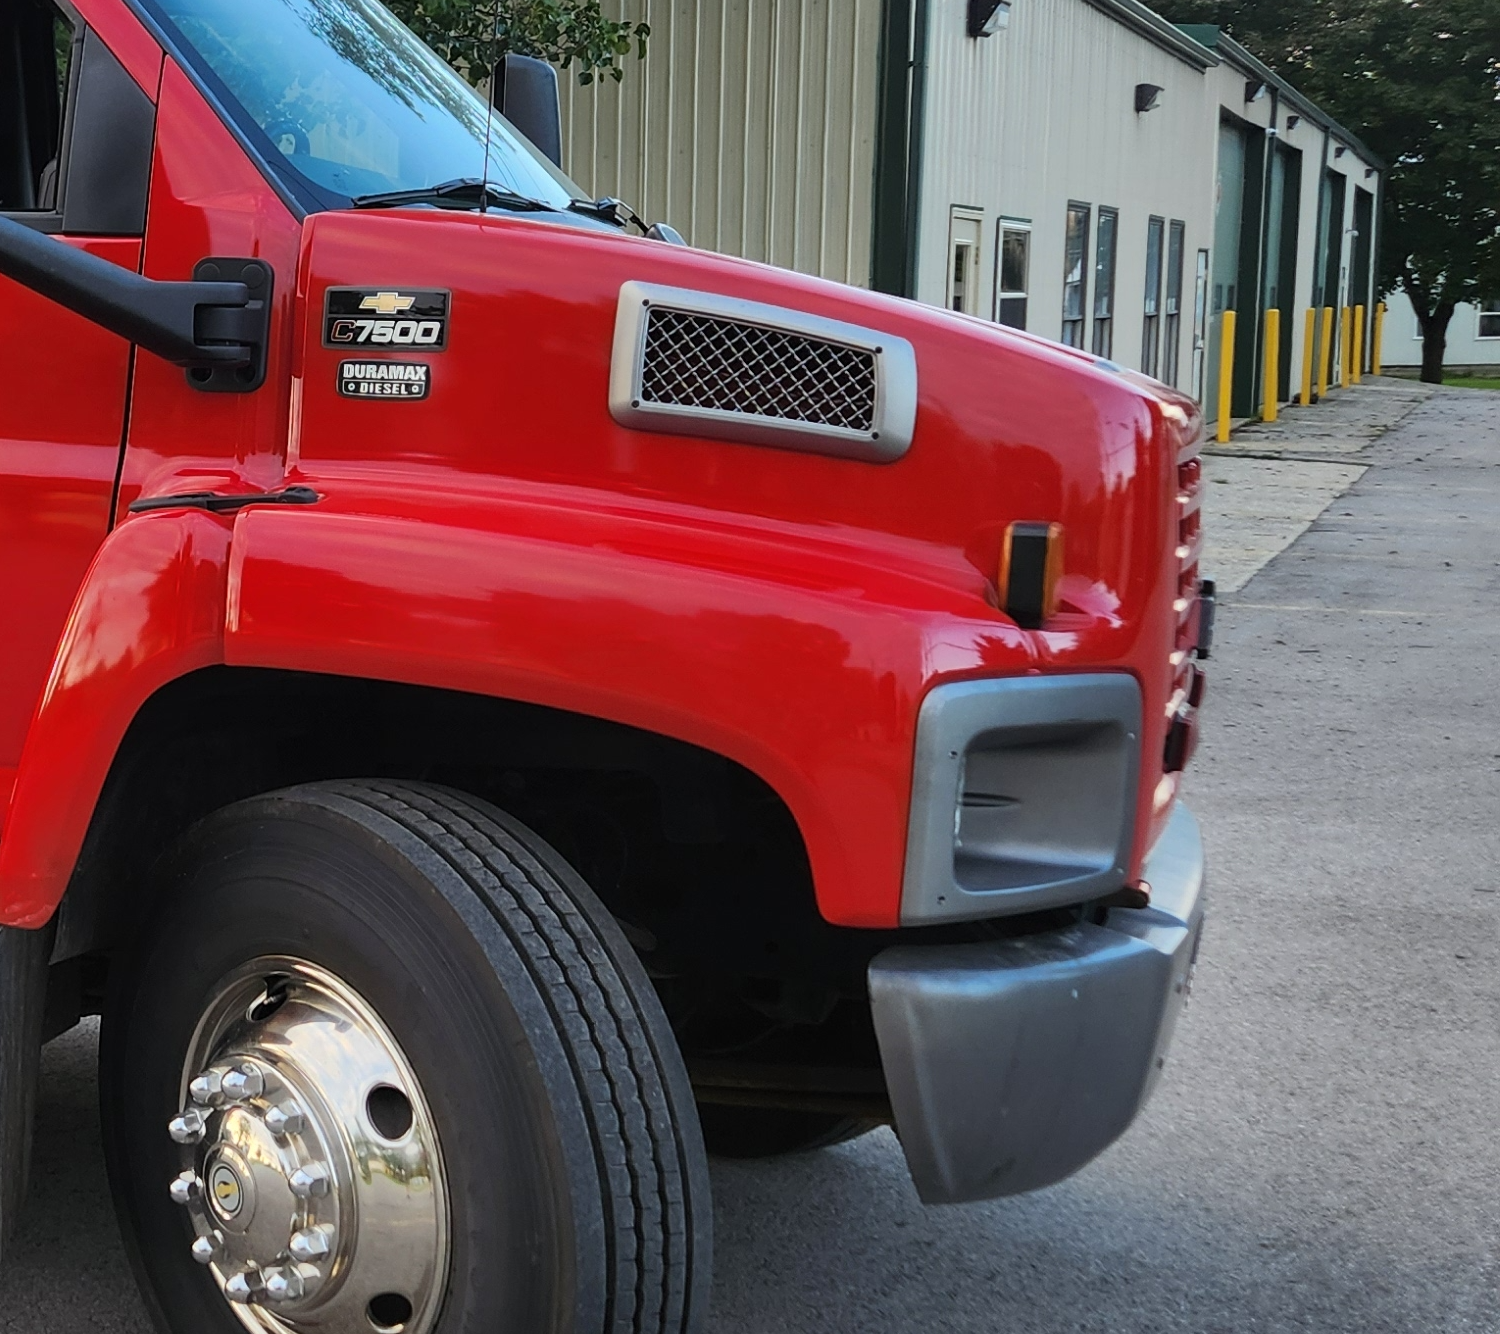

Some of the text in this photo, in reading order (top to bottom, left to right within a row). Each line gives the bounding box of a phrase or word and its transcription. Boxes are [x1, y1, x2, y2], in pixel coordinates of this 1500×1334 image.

[331, 320, 440, 343] C7500
[343, 364, 427, 380] DURAMAX
[359, 382, 408, 394] DIESEL
